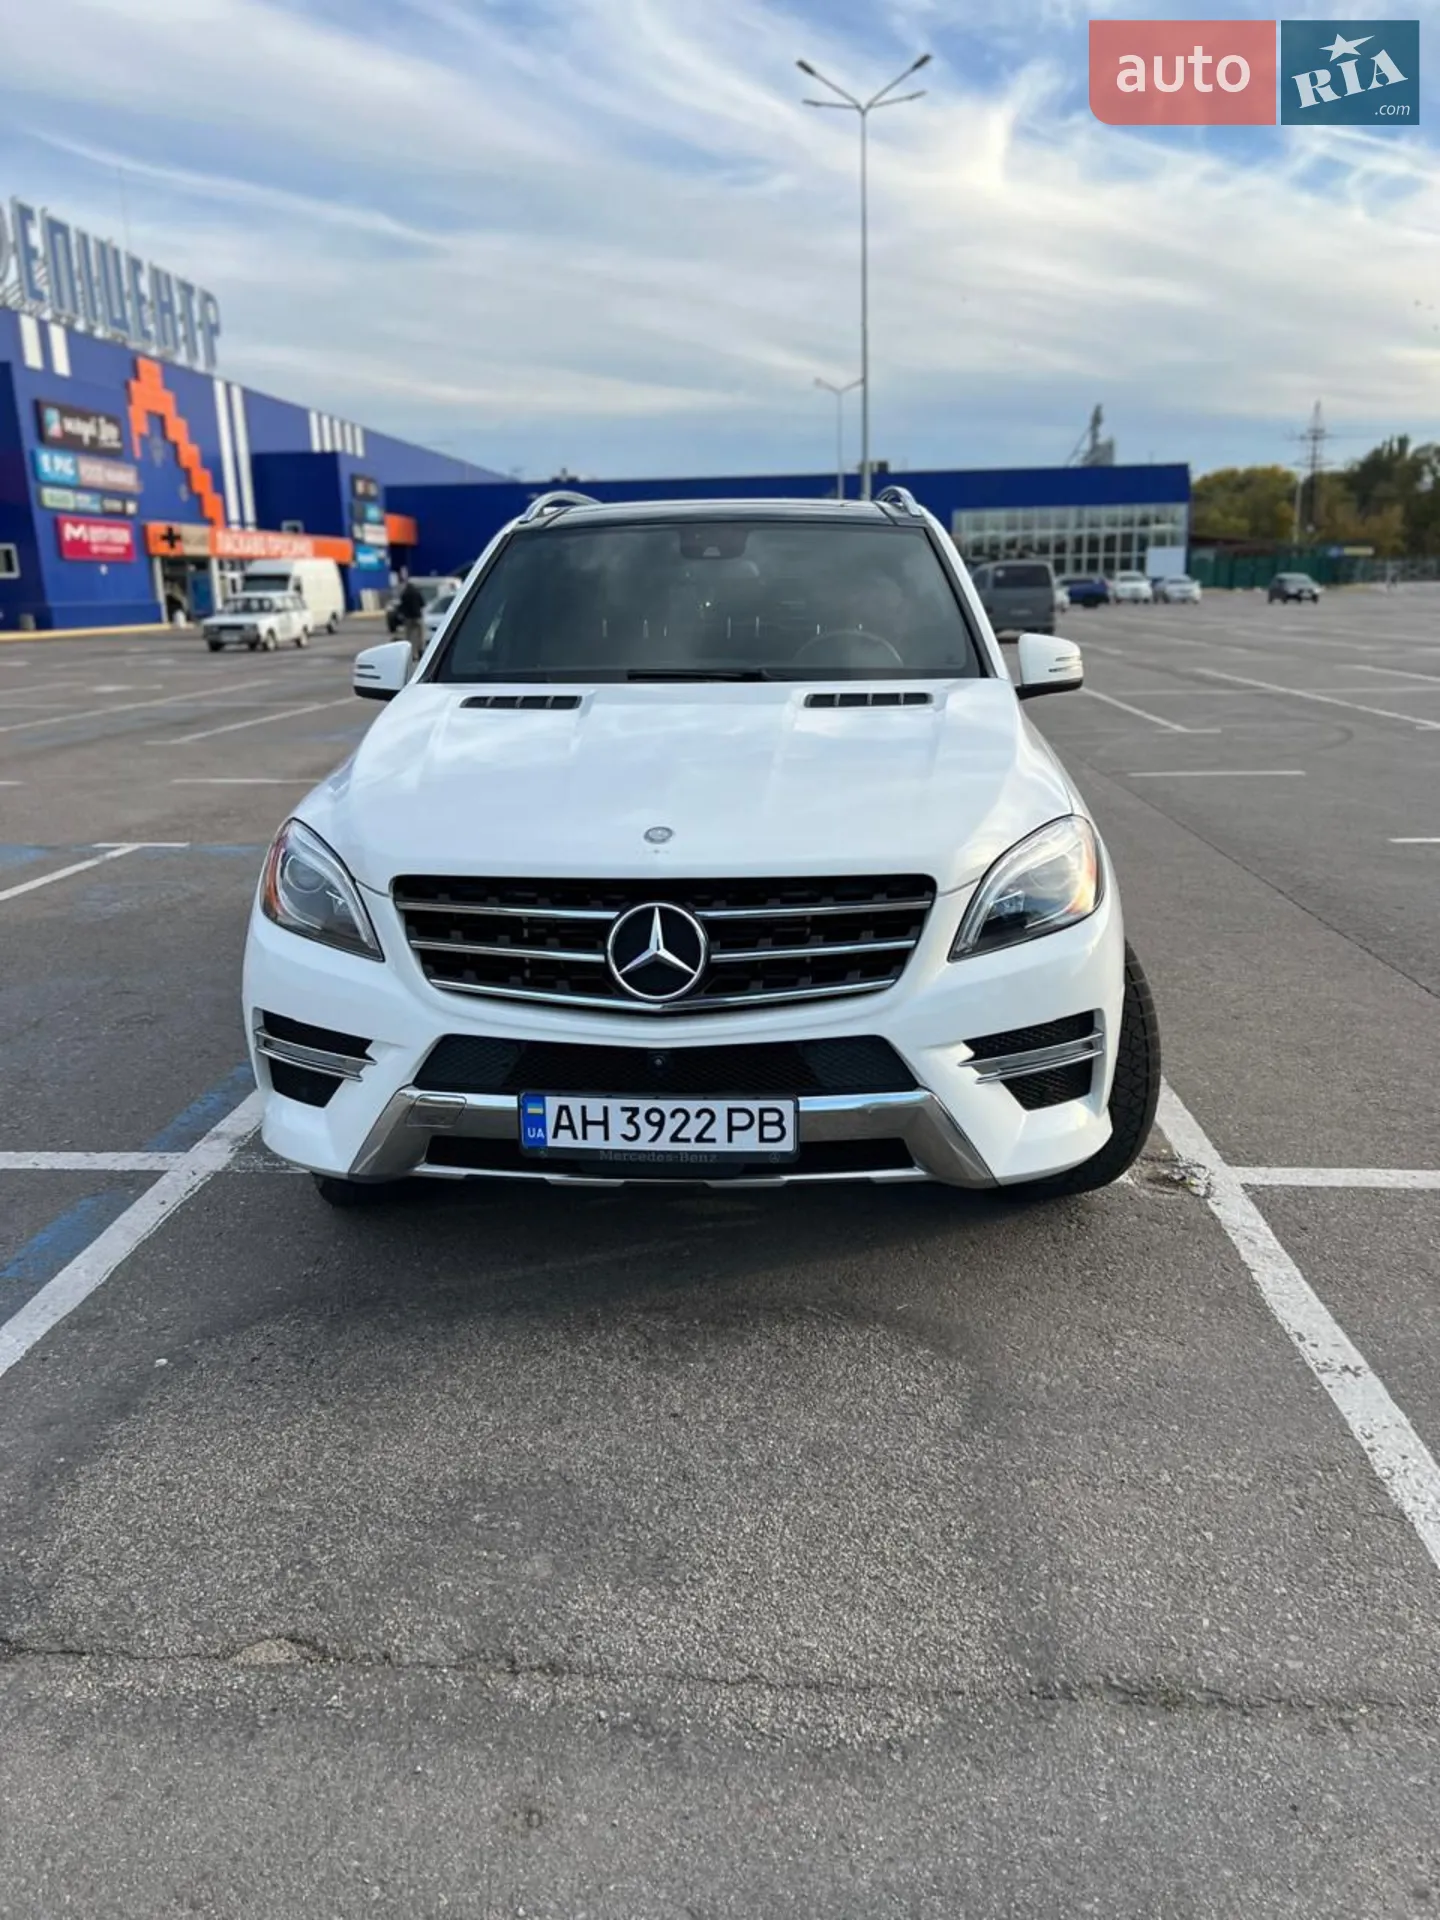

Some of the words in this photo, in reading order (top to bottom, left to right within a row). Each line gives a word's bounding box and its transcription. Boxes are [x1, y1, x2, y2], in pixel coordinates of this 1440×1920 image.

[551, 1104, 610, 1142] AH
[619, 1106, 717, 1144] 3922
[726, 1107, 788, 1144] PB
[527, 1127, 546, 1139] UA
[599, 1151, 718, 1163] Mercedes-Benz
